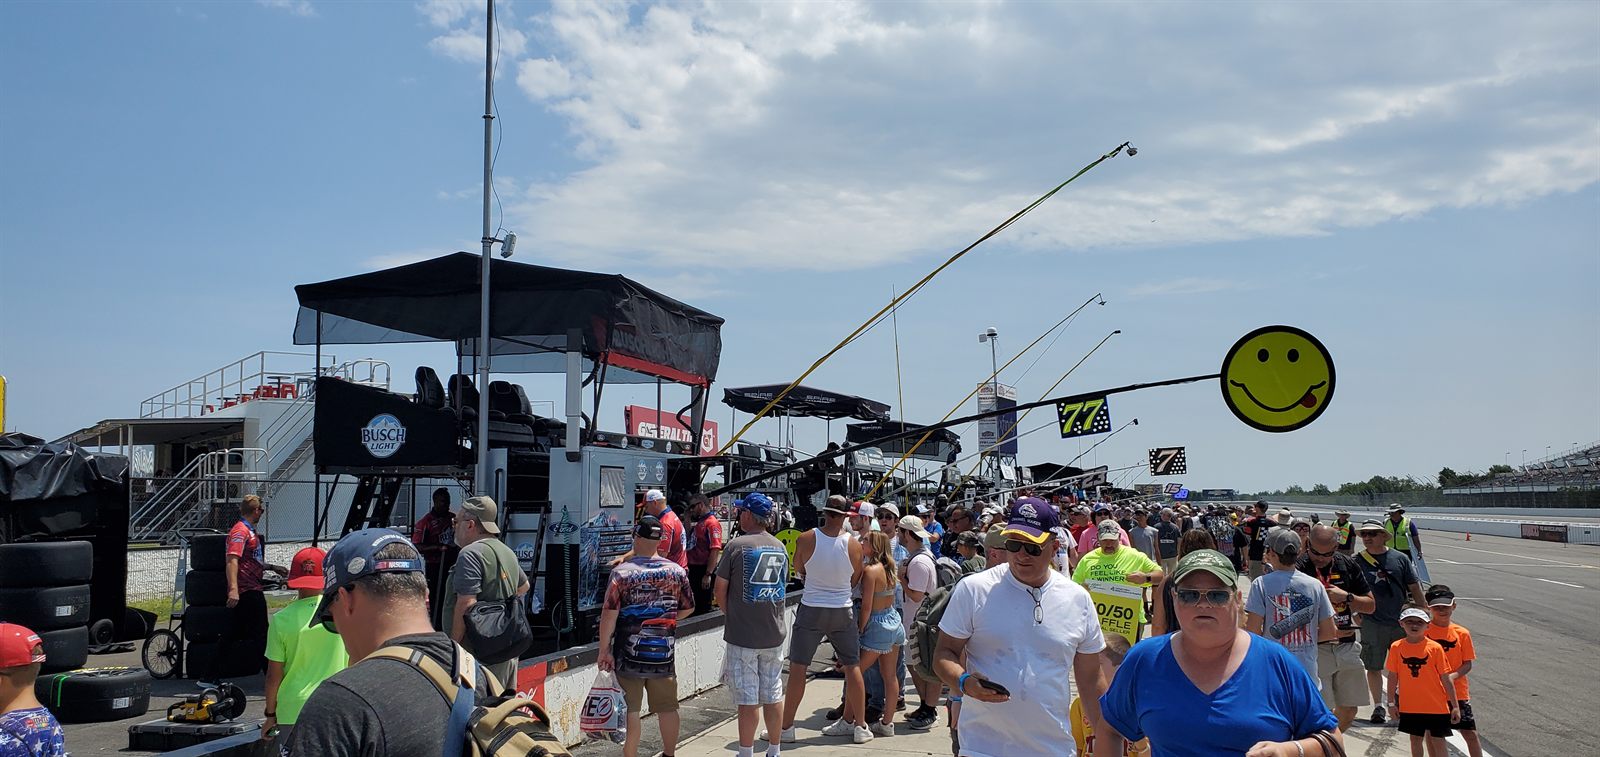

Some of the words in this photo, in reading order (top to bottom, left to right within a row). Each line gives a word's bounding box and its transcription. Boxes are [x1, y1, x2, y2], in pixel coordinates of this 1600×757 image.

[1062, 399, 1104, 433] 77
[362, 428, 405, 443] BUSCH
[370, 442, 396, 450] LIGHT
[1156, 449, 1179, 472] 7
[1166, 483, 1182, 495] 15
[514, 550, 535, 558] BUSC
[750, 551, 786, 585] 6
[1094, 601, 1133, 620] 0/50
[1101, 617, 1132, 630] FFLE
[1110, 627, 1131, 635] SELLER
